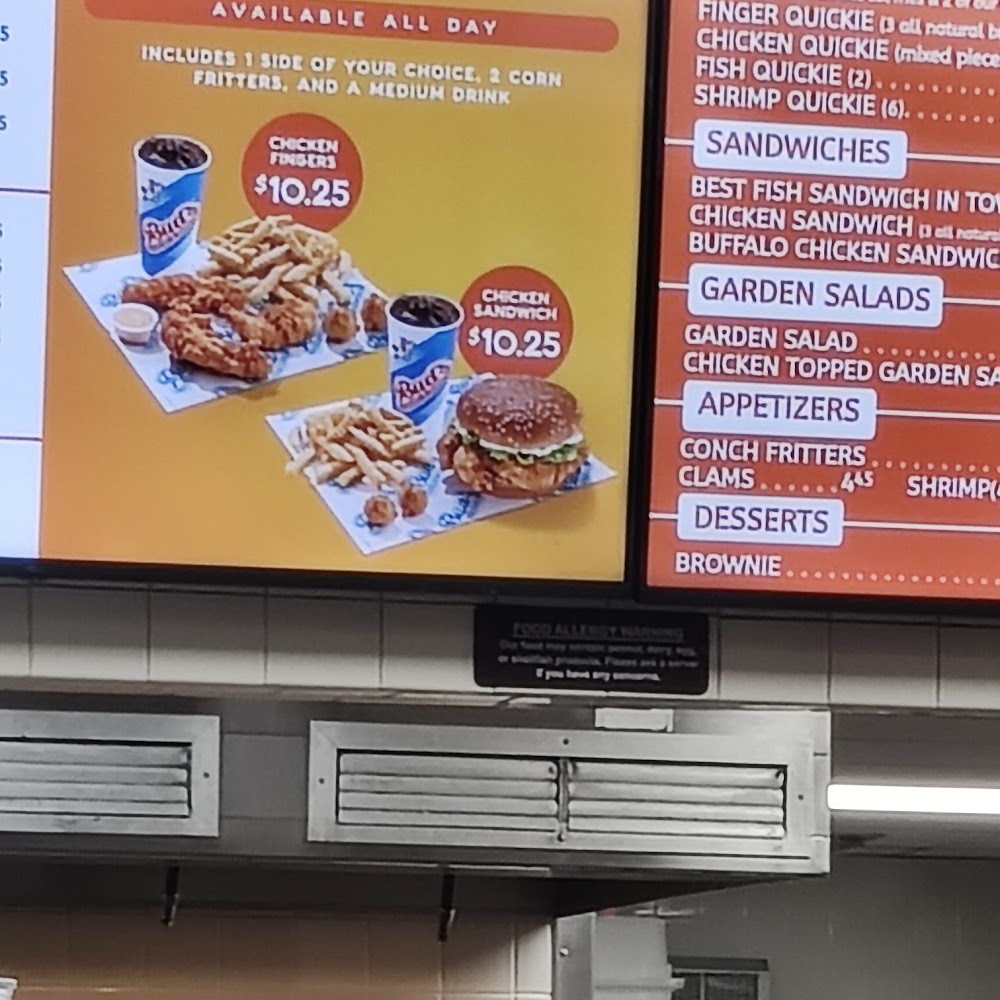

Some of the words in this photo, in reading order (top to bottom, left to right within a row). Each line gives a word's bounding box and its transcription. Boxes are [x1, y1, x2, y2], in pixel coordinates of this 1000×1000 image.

[212, 1, 365, 28] AVAILABLE
[383, 13, 430, 32] ALL
[447, 17, 497, 36] DAY
[698, 0, 779, 26] FINGER
[785, 5, 875, 32] QUICKIE
[925, 21, 985, 40] natural
[697, 28, 793, 54] CHICKEN
[800, 34, 889, 61] QUICKIE
[141, 44, 236, 67] INCLUDES
[244, 52, 253, 67] 1
[260, 53, 303, 71] SIDE
[310, 57, 336, 73] OF
[344, 59, 397, 77] YOUR
[489, 67, 500, 84] 2
[508, 70, 562, 87] CORN
[696, 55, 746, 80] FISH
[752, 60, 842, 86] QUICKIE
[847, 68, 872, 90] (2)
[297, 77, 339, 95] AND
[346, 80, 361, 96] A
[369, 80, 444, 101] MEDIUM
[452, 86, 511, 105] DRINK
[694, 84, 781, 110] SHRIMP
[786, 90, 876, 116] QUICKIE
[881, 98, 905, 119] (6)
[269, 135, 339, 154] CHICKEN
[270, 152, 336, 169] FINGERS
[706, 129, 890, 164] SANDWICHES
[254, 173, 350, 207] $10.25
[691, 175, 747, 200] BEST
[753, 179, 802, 203] FISH
[808, 182, 930, 211] SANDWICH
[936, 190, 959, 212] IN
[689, 204, 786, 231] CHICKEN
[791, 209, 913, 238] SANDWICH
[689, 231, 788, 257] BUFFALO
[795, 237, 890, 264] CHICKEN
[482, 288, 550, 305] CHICKEN
[701, 276, 814, 306] GARDEN
[825, 282, 930, 312] SALADS
[473, 303, 557, 321] SANDWICH
[468, 325, 561, 358] $10.25
[684, 324, 777, 349] GARDEN
[783, 329, 858, 353] SALAD
[683, 351, 780, 377] CHICKEN
[785, 356, 873, 381] TOPPED
[878, 361, 970, 387] GARDEN
[698, 391, 860, 422] APPETIZERS
[679, 437, 759, 462] CONCH
[766, 441, 866, 466] FRITTERS
[678, 465, 755, 489] CLAMS
[694, 505, 829, 534] DESSERTS
[675, 551, 782, 577] BROWNIE
